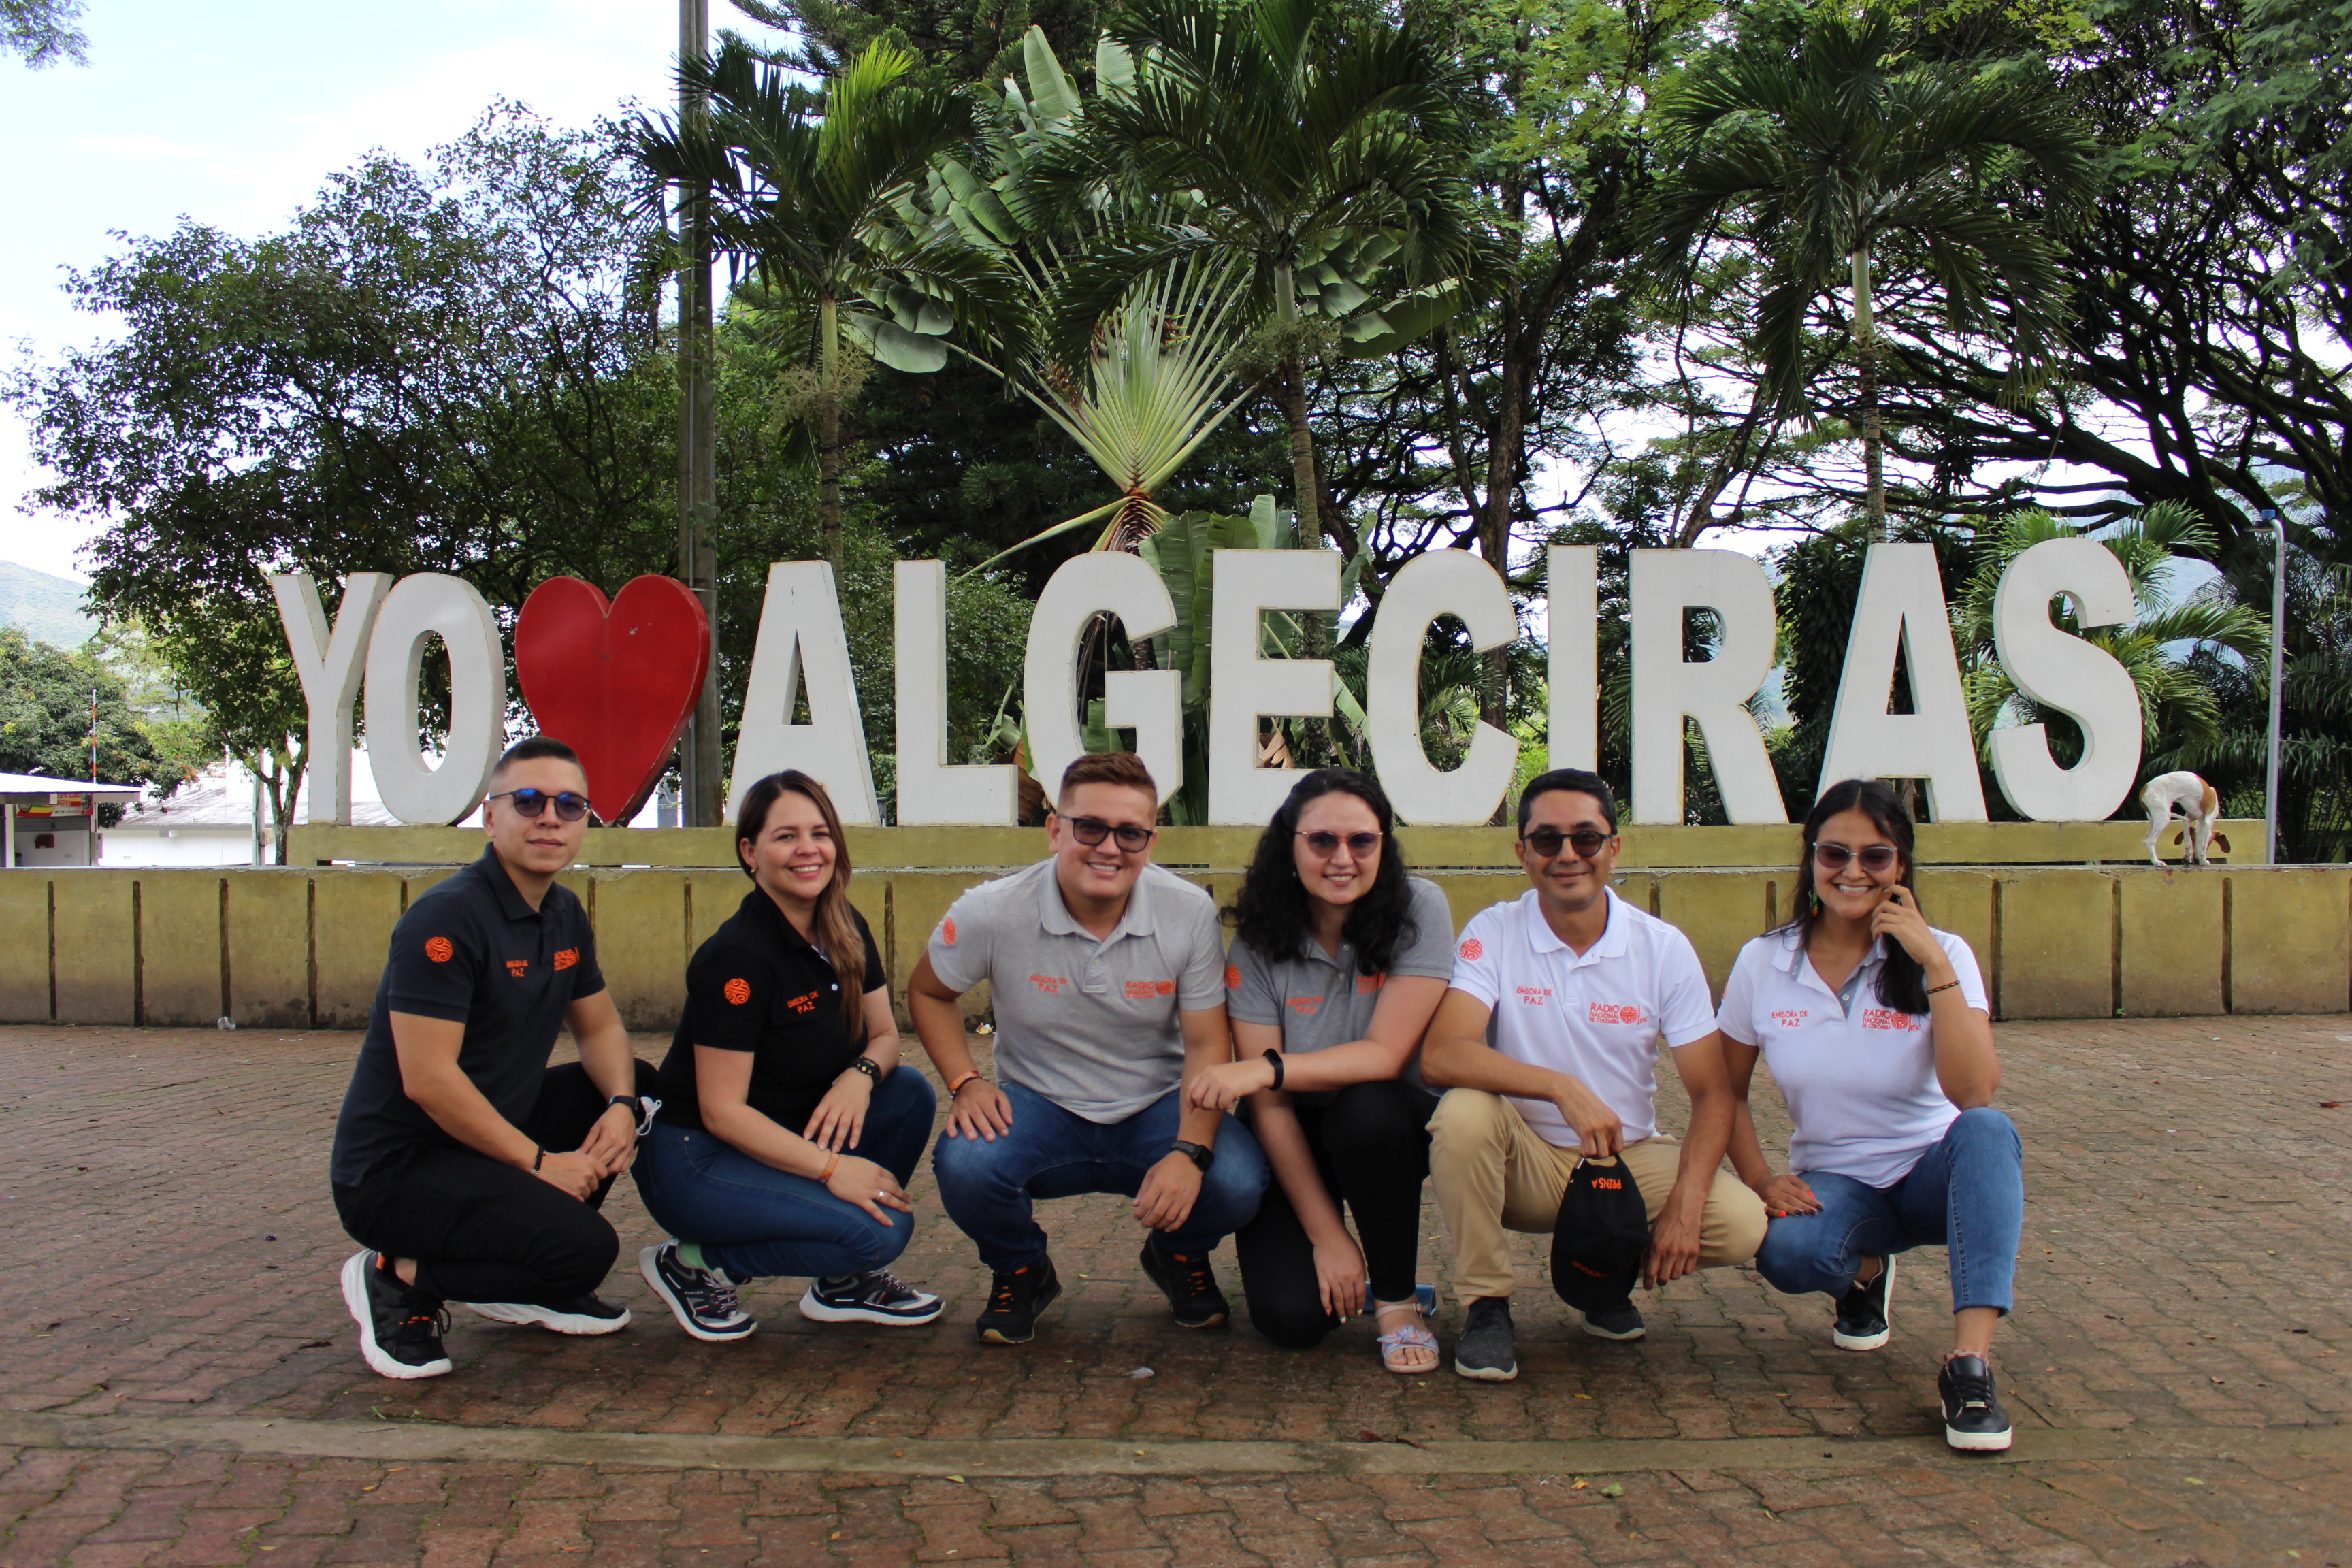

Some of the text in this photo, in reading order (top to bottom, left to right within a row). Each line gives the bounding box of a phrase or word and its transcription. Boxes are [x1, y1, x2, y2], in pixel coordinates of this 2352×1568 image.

[271, 536, 2143, 828] YO ALGECIRAS
[511, 968, 525, 977] PAZ
[1038, 983, 1059, 994] PAZ
[1126, 981, 1156, 989] RADIO
[809, 990, 819, 999] DE
[1524, 996, 1544, 1005] PAZ
[797, 1001, 815, 1014] PAZ
[1295, 1004, 1316, 1014] PAZ
[1591, 1002, 1620, 1013] RADIO
[1863, 1009, 1891, 1019] RADIO
[1781, 1019, 1800, 1027] PAZ
[1591, 1177, 1622, 1189] PRENSA
